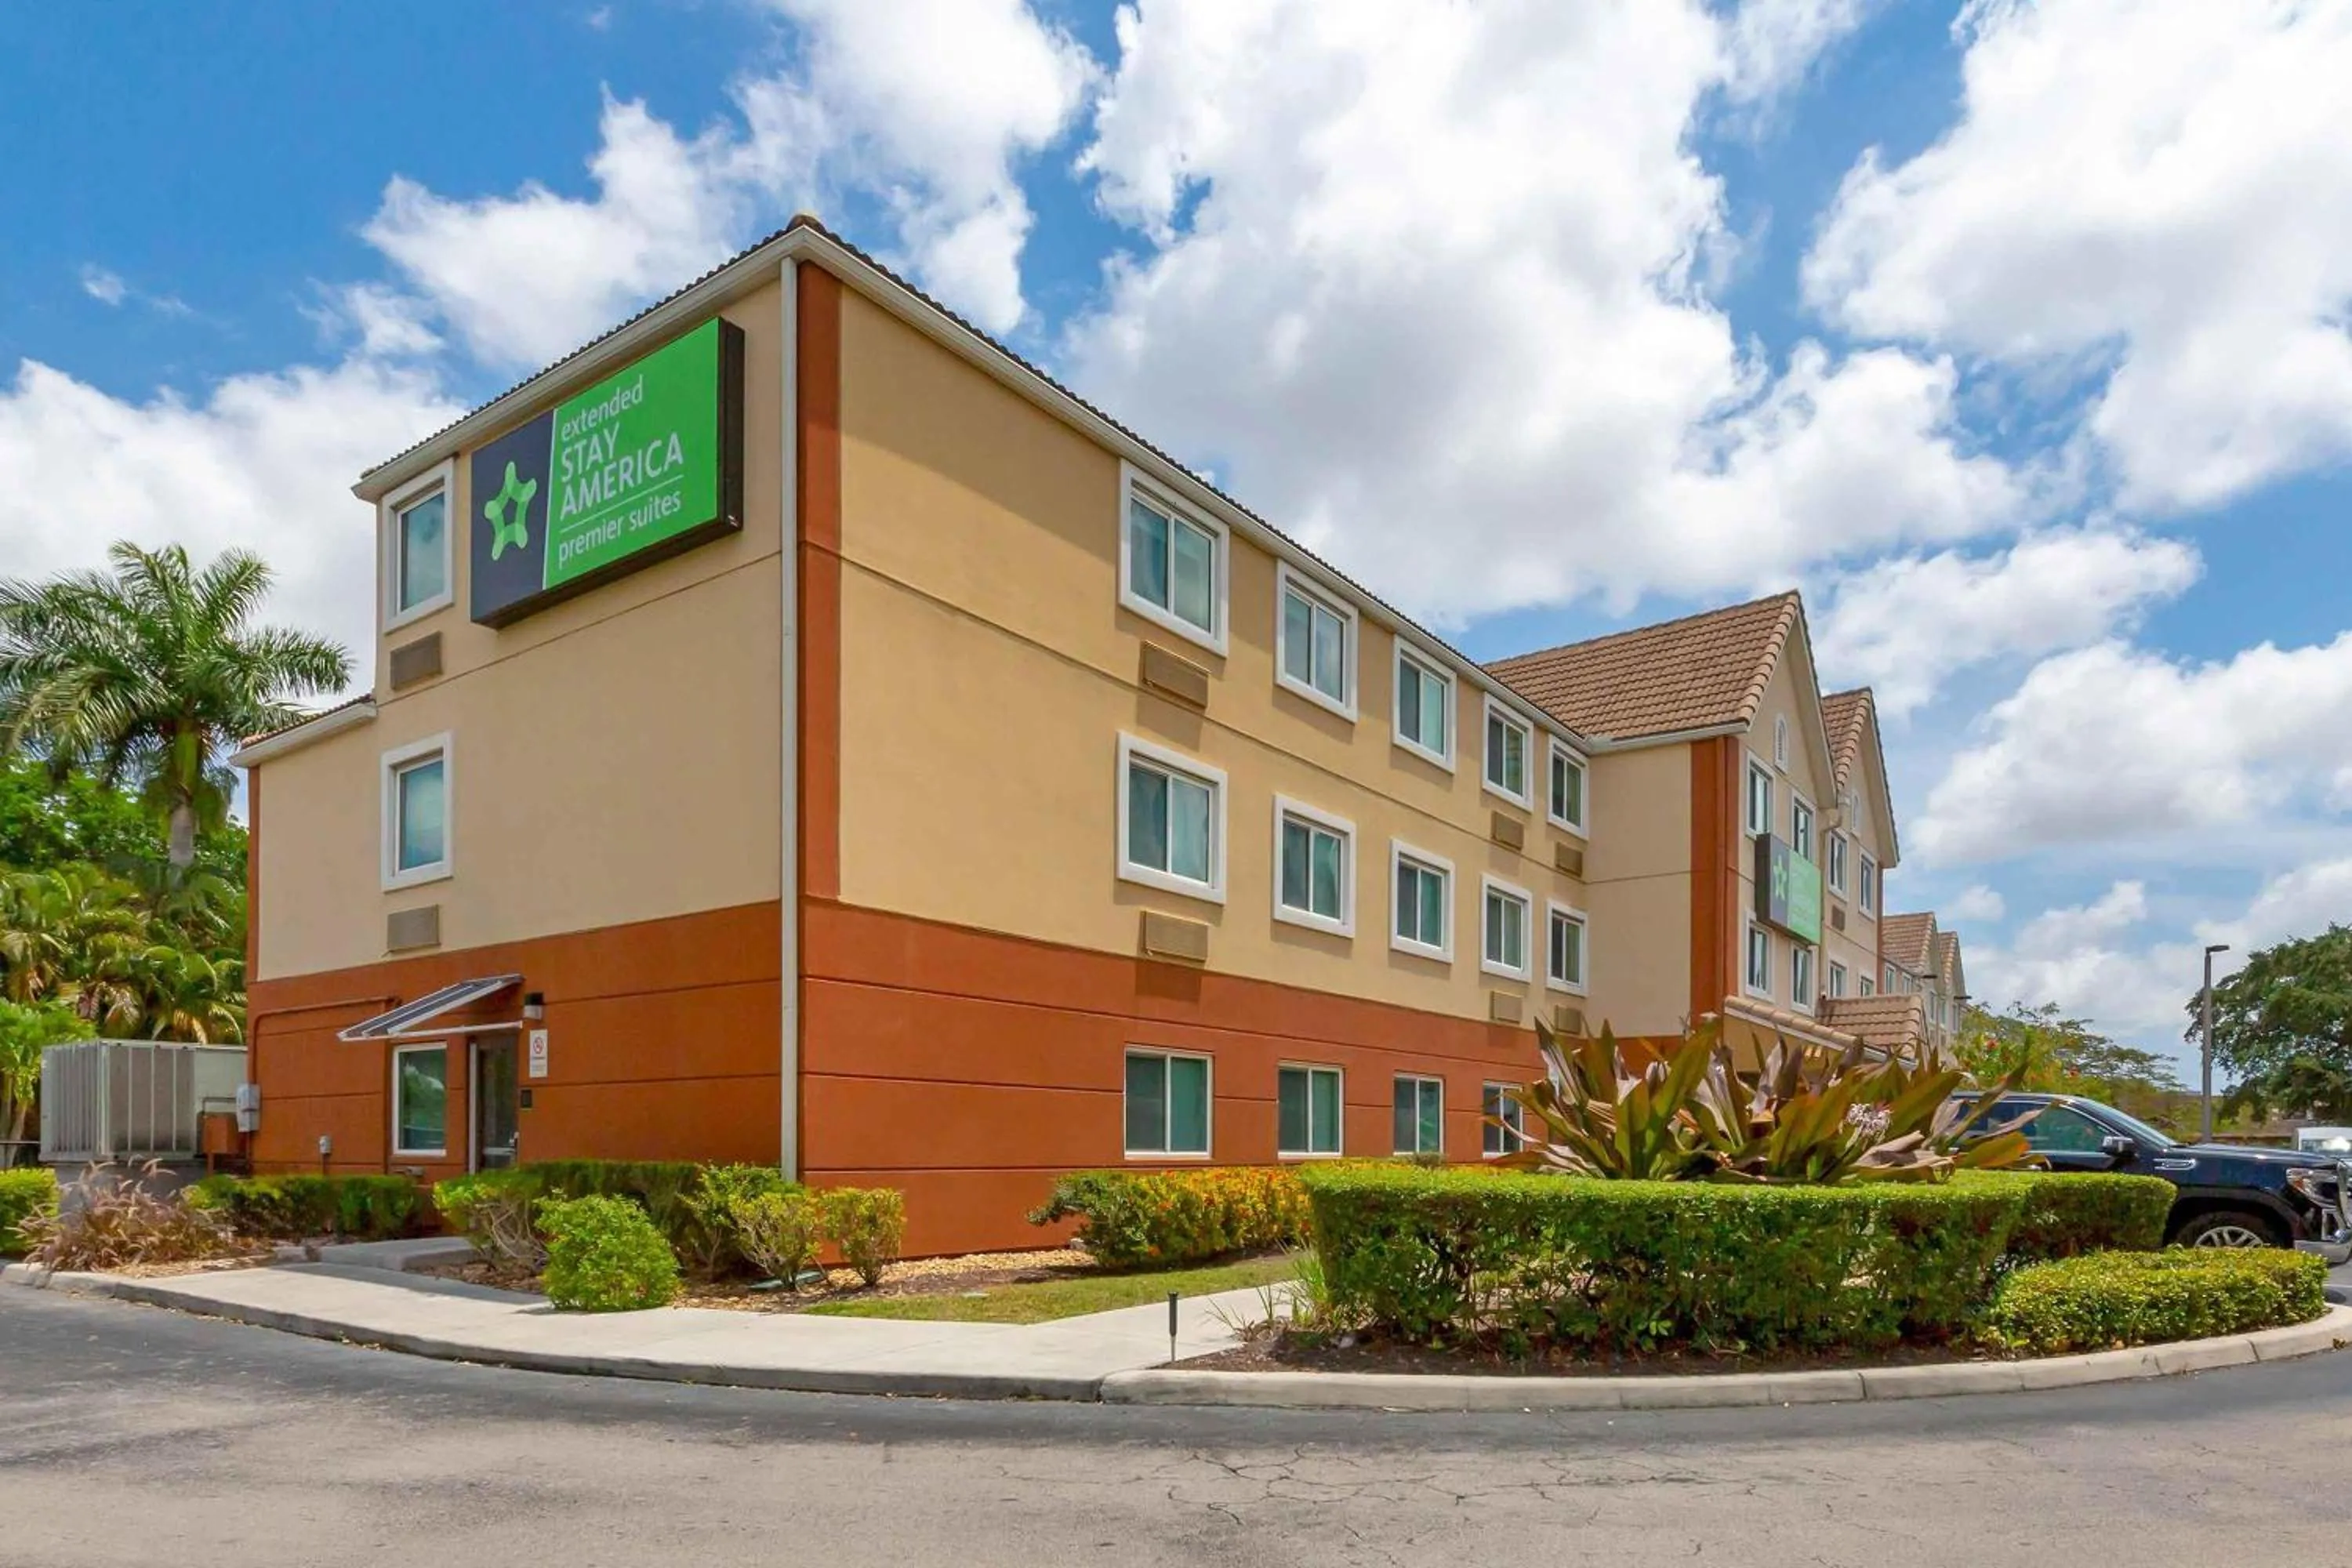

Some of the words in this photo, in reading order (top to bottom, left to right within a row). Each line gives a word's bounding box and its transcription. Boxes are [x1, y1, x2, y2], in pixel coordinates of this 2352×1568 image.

[561, 374, 644, 442] extended
[560, 432, 684, 521] AMERICA
[561, 421, 619, 483] STAY
[559, 517, 624, 570] premier
[629, 491, 681, 531] suites
